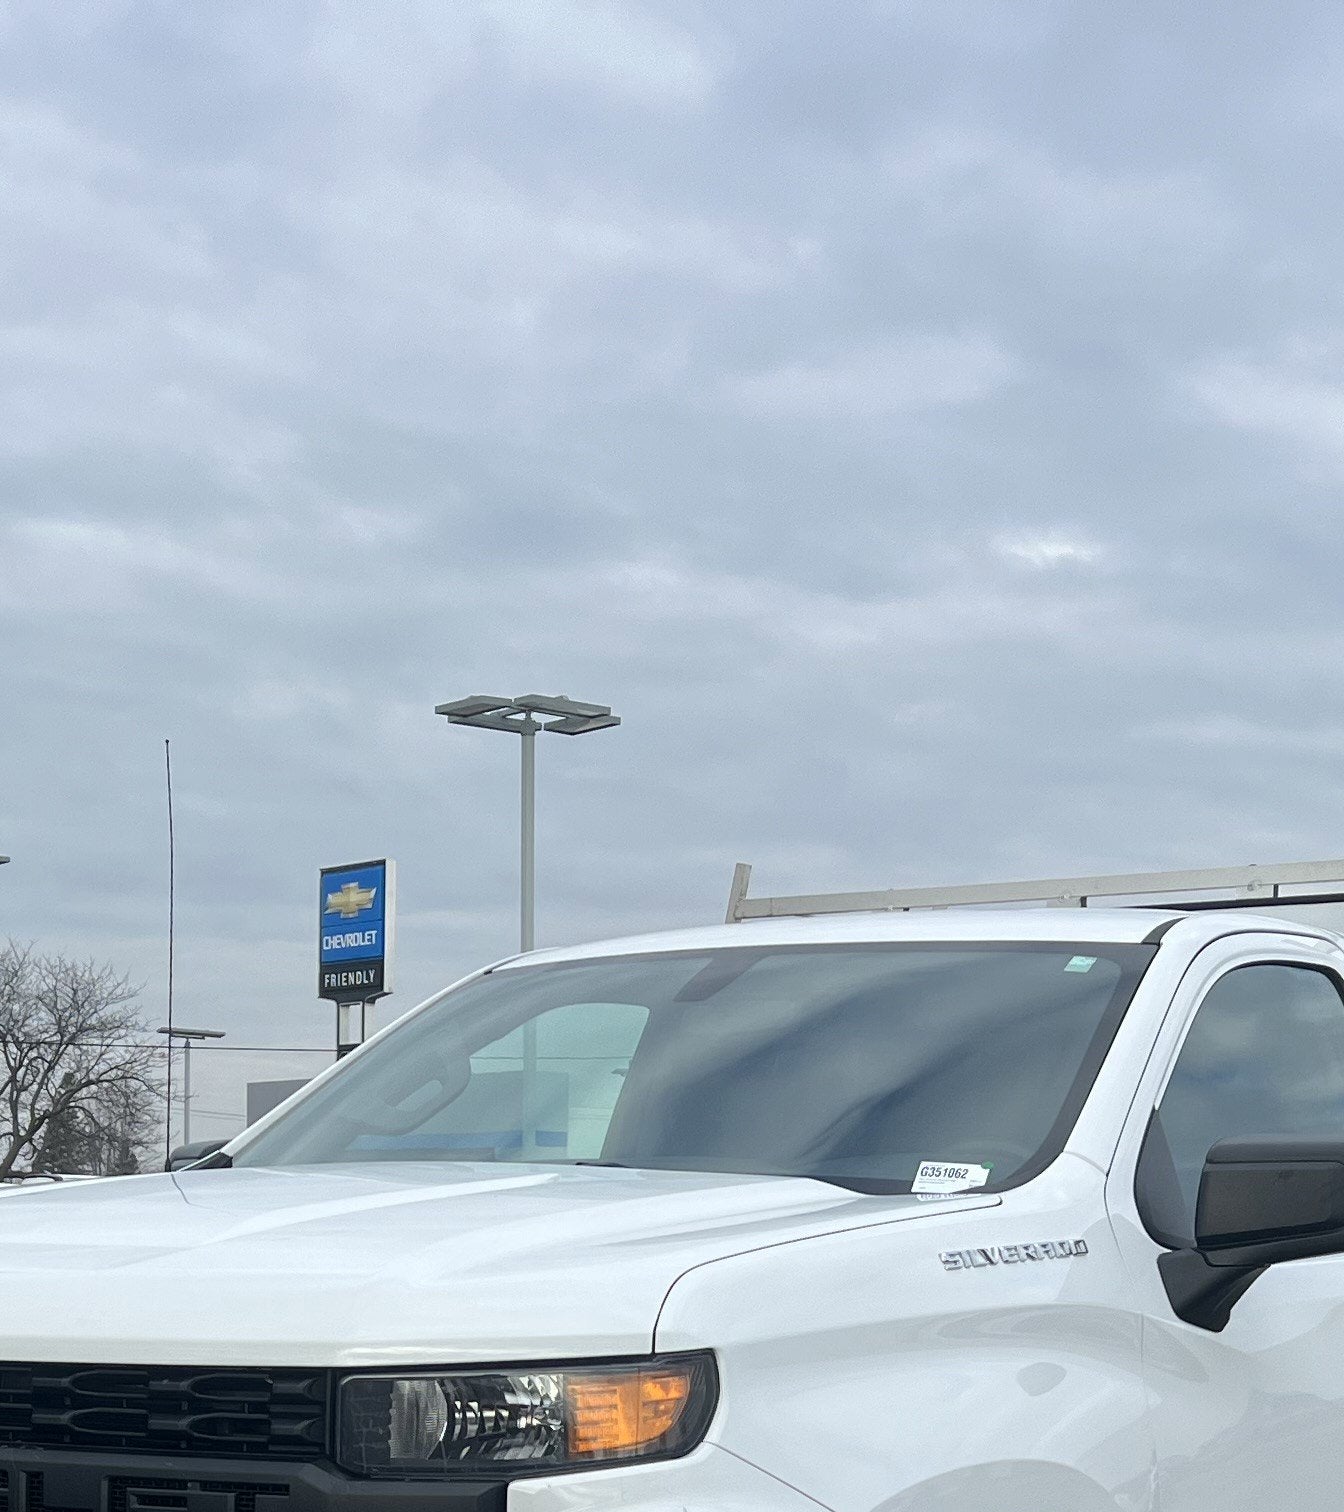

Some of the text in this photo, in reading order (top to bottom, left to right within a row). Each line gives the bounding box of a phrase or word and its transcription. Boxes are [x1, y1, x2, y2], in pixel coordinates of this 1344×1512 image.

[323, 930, 377, 950] CHEVROLET
[325, 969, 376, 988] FRIENDLY
[938, 1239, 1089, 1271] SILVERADO
